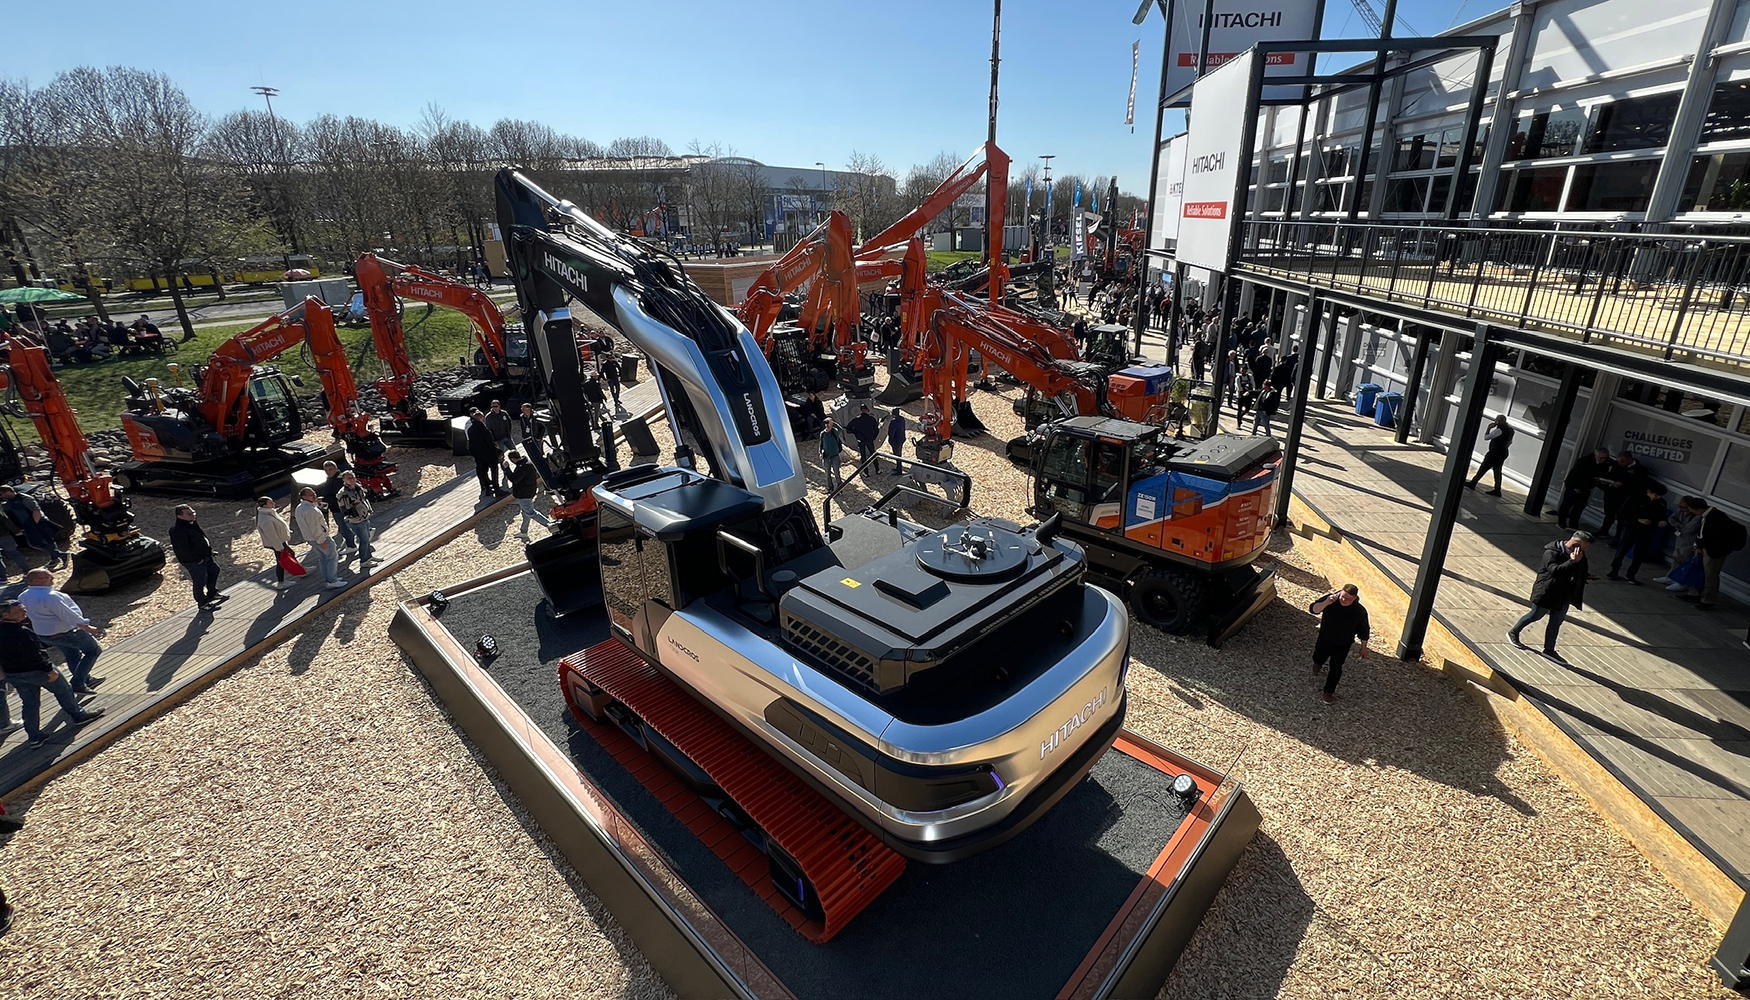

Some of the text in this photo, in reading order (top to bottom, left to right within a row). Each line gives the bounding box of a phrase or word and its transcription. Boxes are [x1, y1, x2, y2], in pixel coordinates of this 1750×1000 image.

[1192, 152, 1225, 174] HITACHI
[1186, 204, 1222, 217] Reliable Solutions
[1075, 212, 1084, 255] KIESEL
[544, 251, 588, 292] HITACHI
[784, 257, 812, 281] HITACHI
[856, 267, 882, 277] HITACHI
[410, 286, 443, 299] HITACHI
[251, 334, 286, 355] HITACHI
[980, 340, 1011, 364] HITACHI
[743, 392, 761, 437] LANDCROS
[1624, 430, 1693, 450] CHALLENGES
[1626, 442, 1685, 462] ACCEPTED
[667, 635, 700, 663] LANDCROS
[1039, 685, 1108, 761] HITACHI
